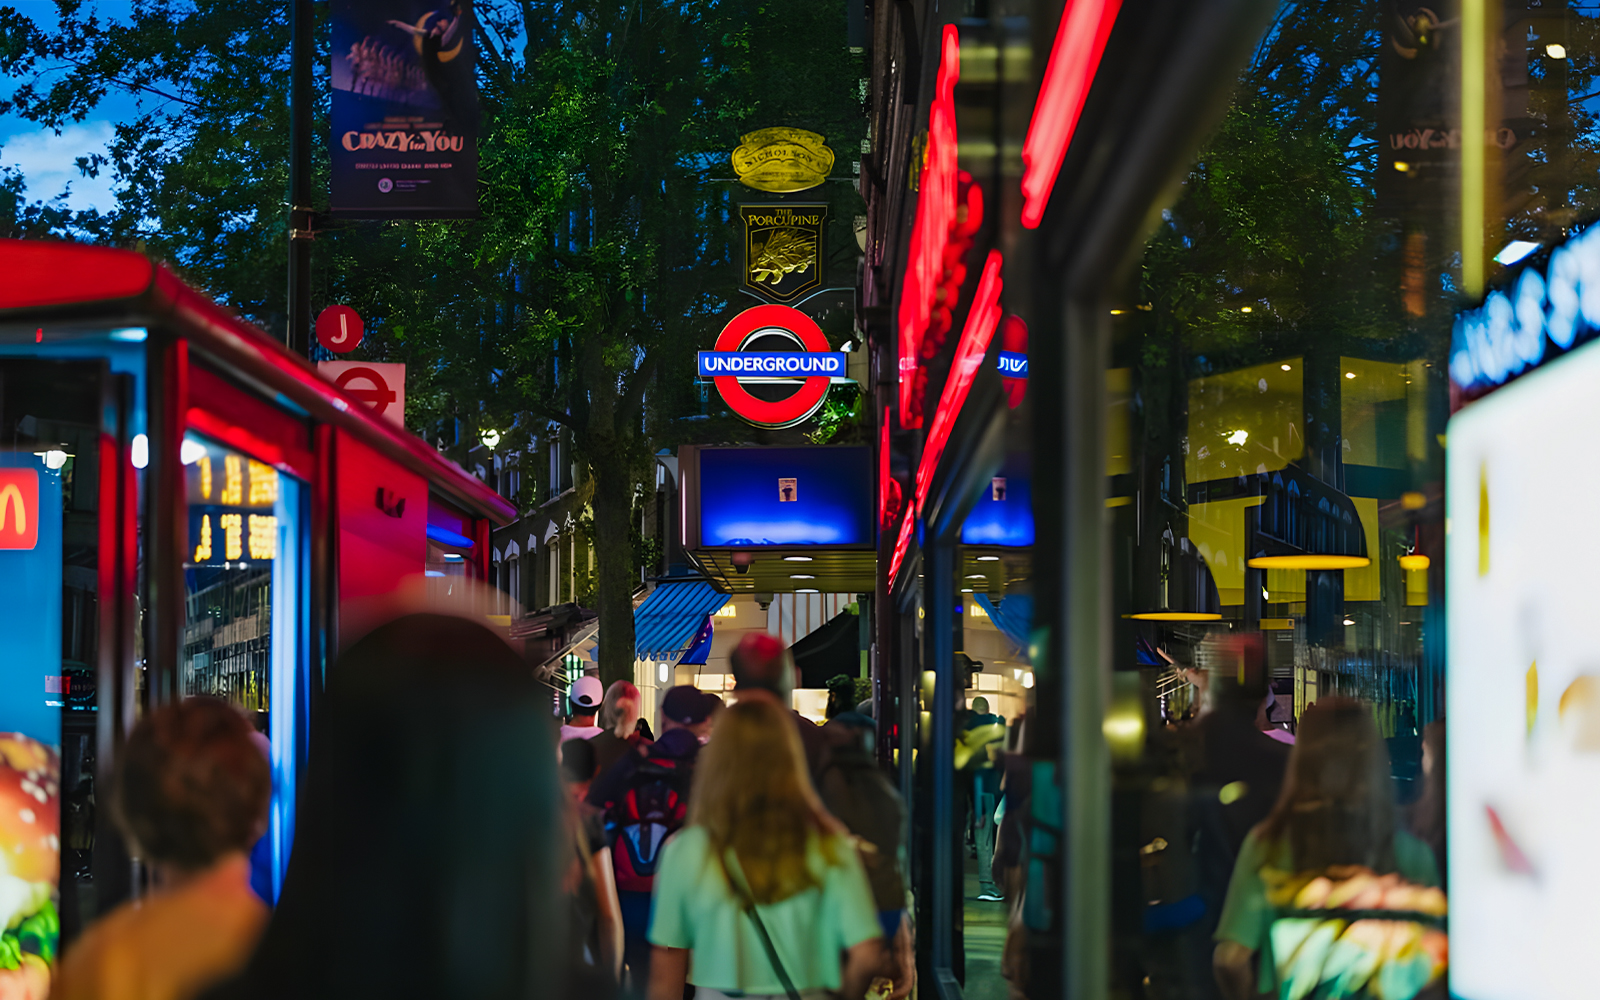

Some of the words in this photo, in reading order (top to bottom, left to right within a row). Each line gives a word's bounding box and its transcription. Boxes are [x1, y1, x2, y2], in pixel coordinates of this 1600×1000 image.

[341, 130, 414, 152] CRAZY
[748, 214, 820, 226] PORCUPINE
[775, 208, 793, 216] THE
[330, 313, 347, 344] J
[704, 356, 839, 372] UNDERGROUND
